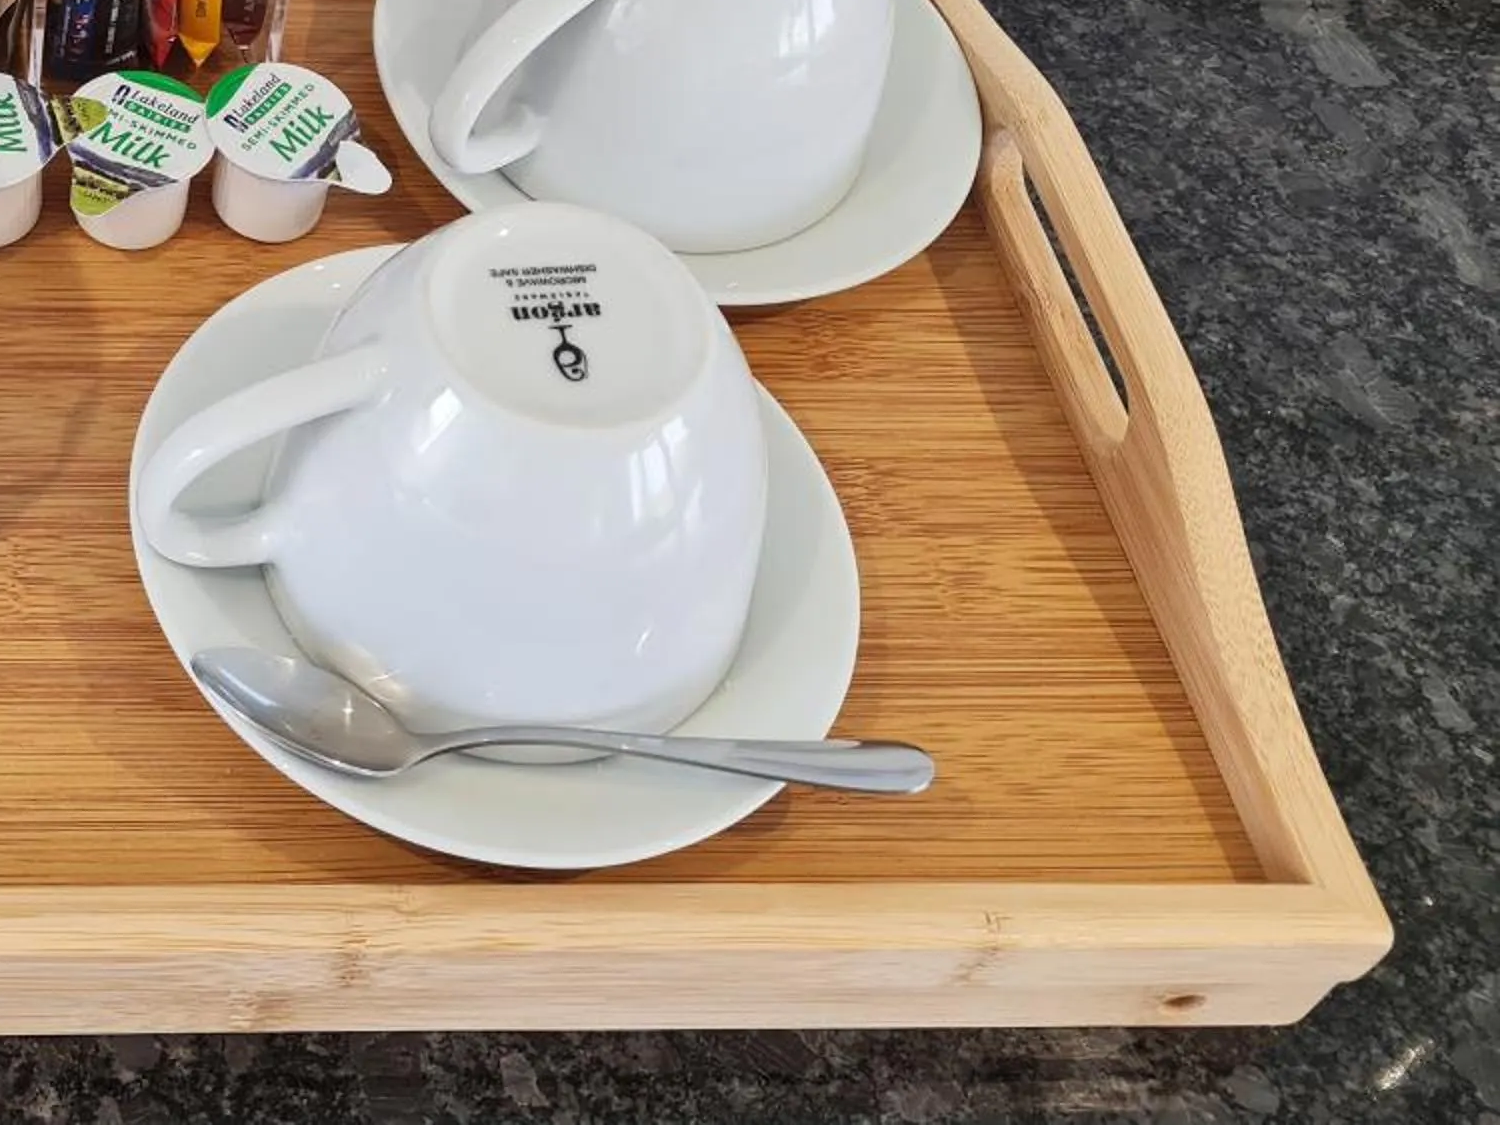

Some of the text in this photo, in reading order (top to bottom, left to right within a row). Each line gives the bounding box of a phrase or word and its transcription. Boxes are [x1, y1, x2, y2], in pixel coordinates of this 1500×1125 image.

[131, 90, 199, 123] Lakeland
[237, 73, 282, 117] Lakeland
[109, 110, 197, 150] MI-SKIMMED
[243, 84, 315, 151] SEMI-SKIMMED
[269, 104, 335, 163] Milk
[88, 121, 171, 169] Milk
[511, 301, 601, 322] argon
